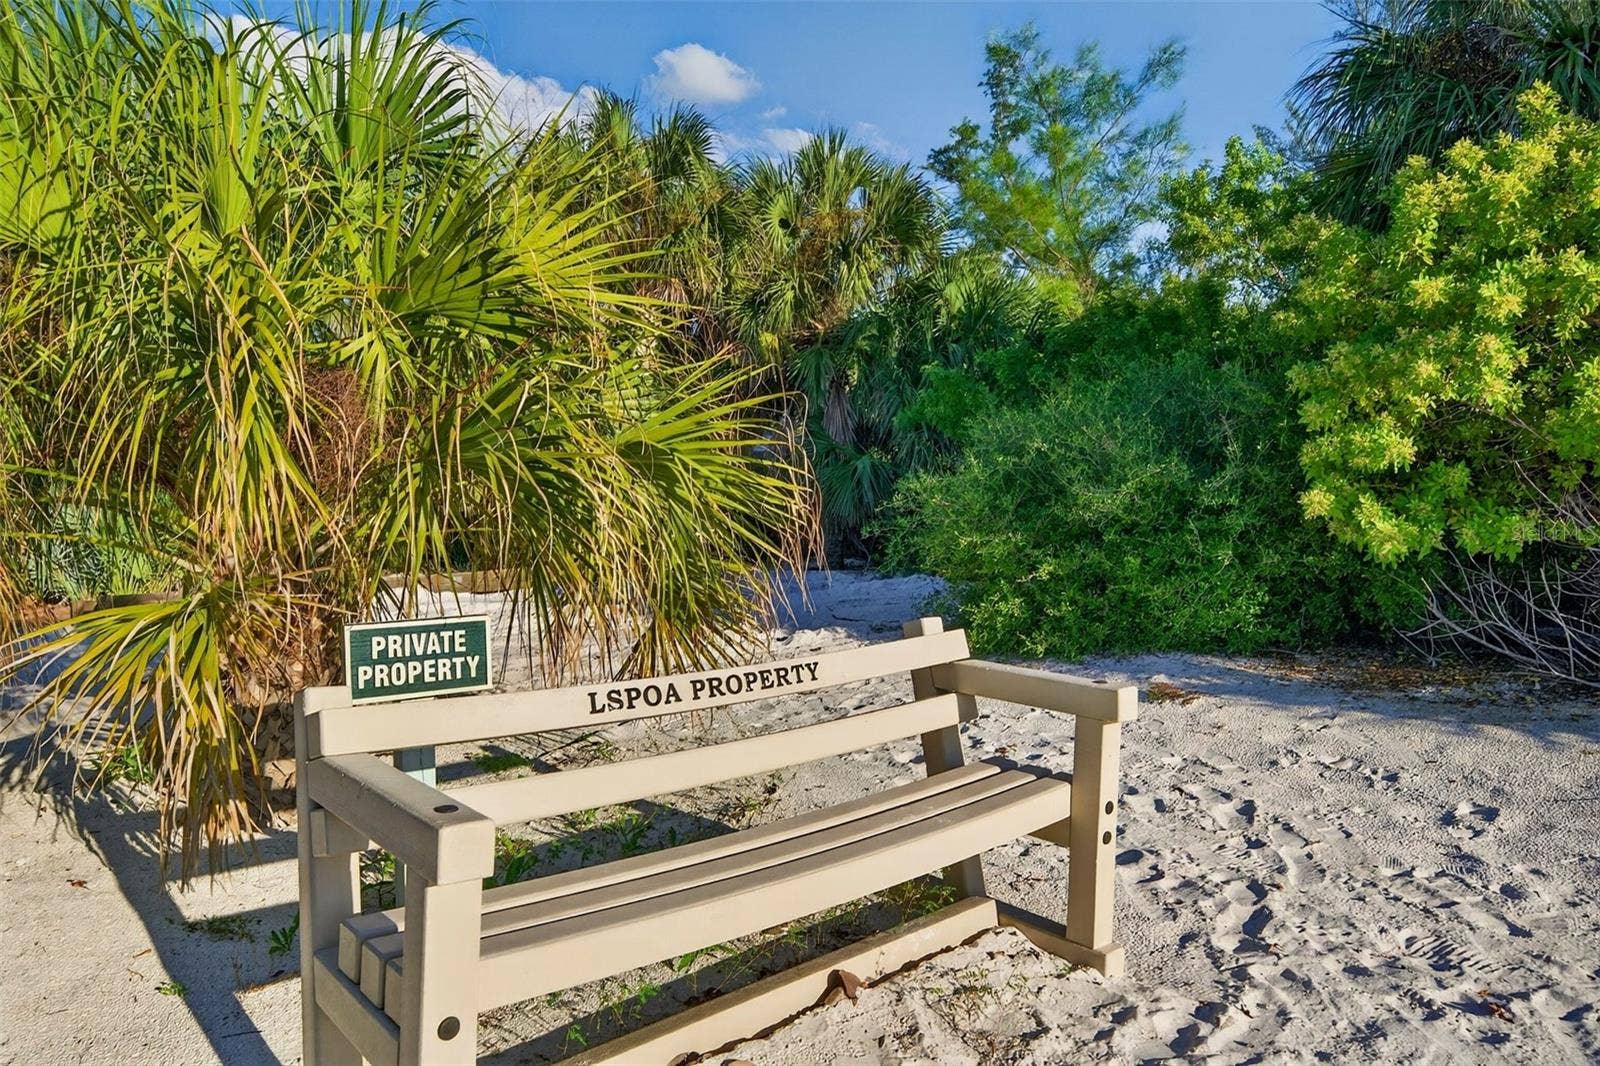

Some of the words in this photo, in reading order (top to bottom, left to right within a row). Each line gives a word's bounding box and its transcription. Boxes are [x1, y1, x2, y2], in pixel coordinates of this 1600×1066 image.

[371, 629, 467, 660] PRIVATE
[357, 655, 480, 690] PROPERTY
[587, 682, 683, 714] LSPOA
[689, 661, 820, 701] PROPERTY
